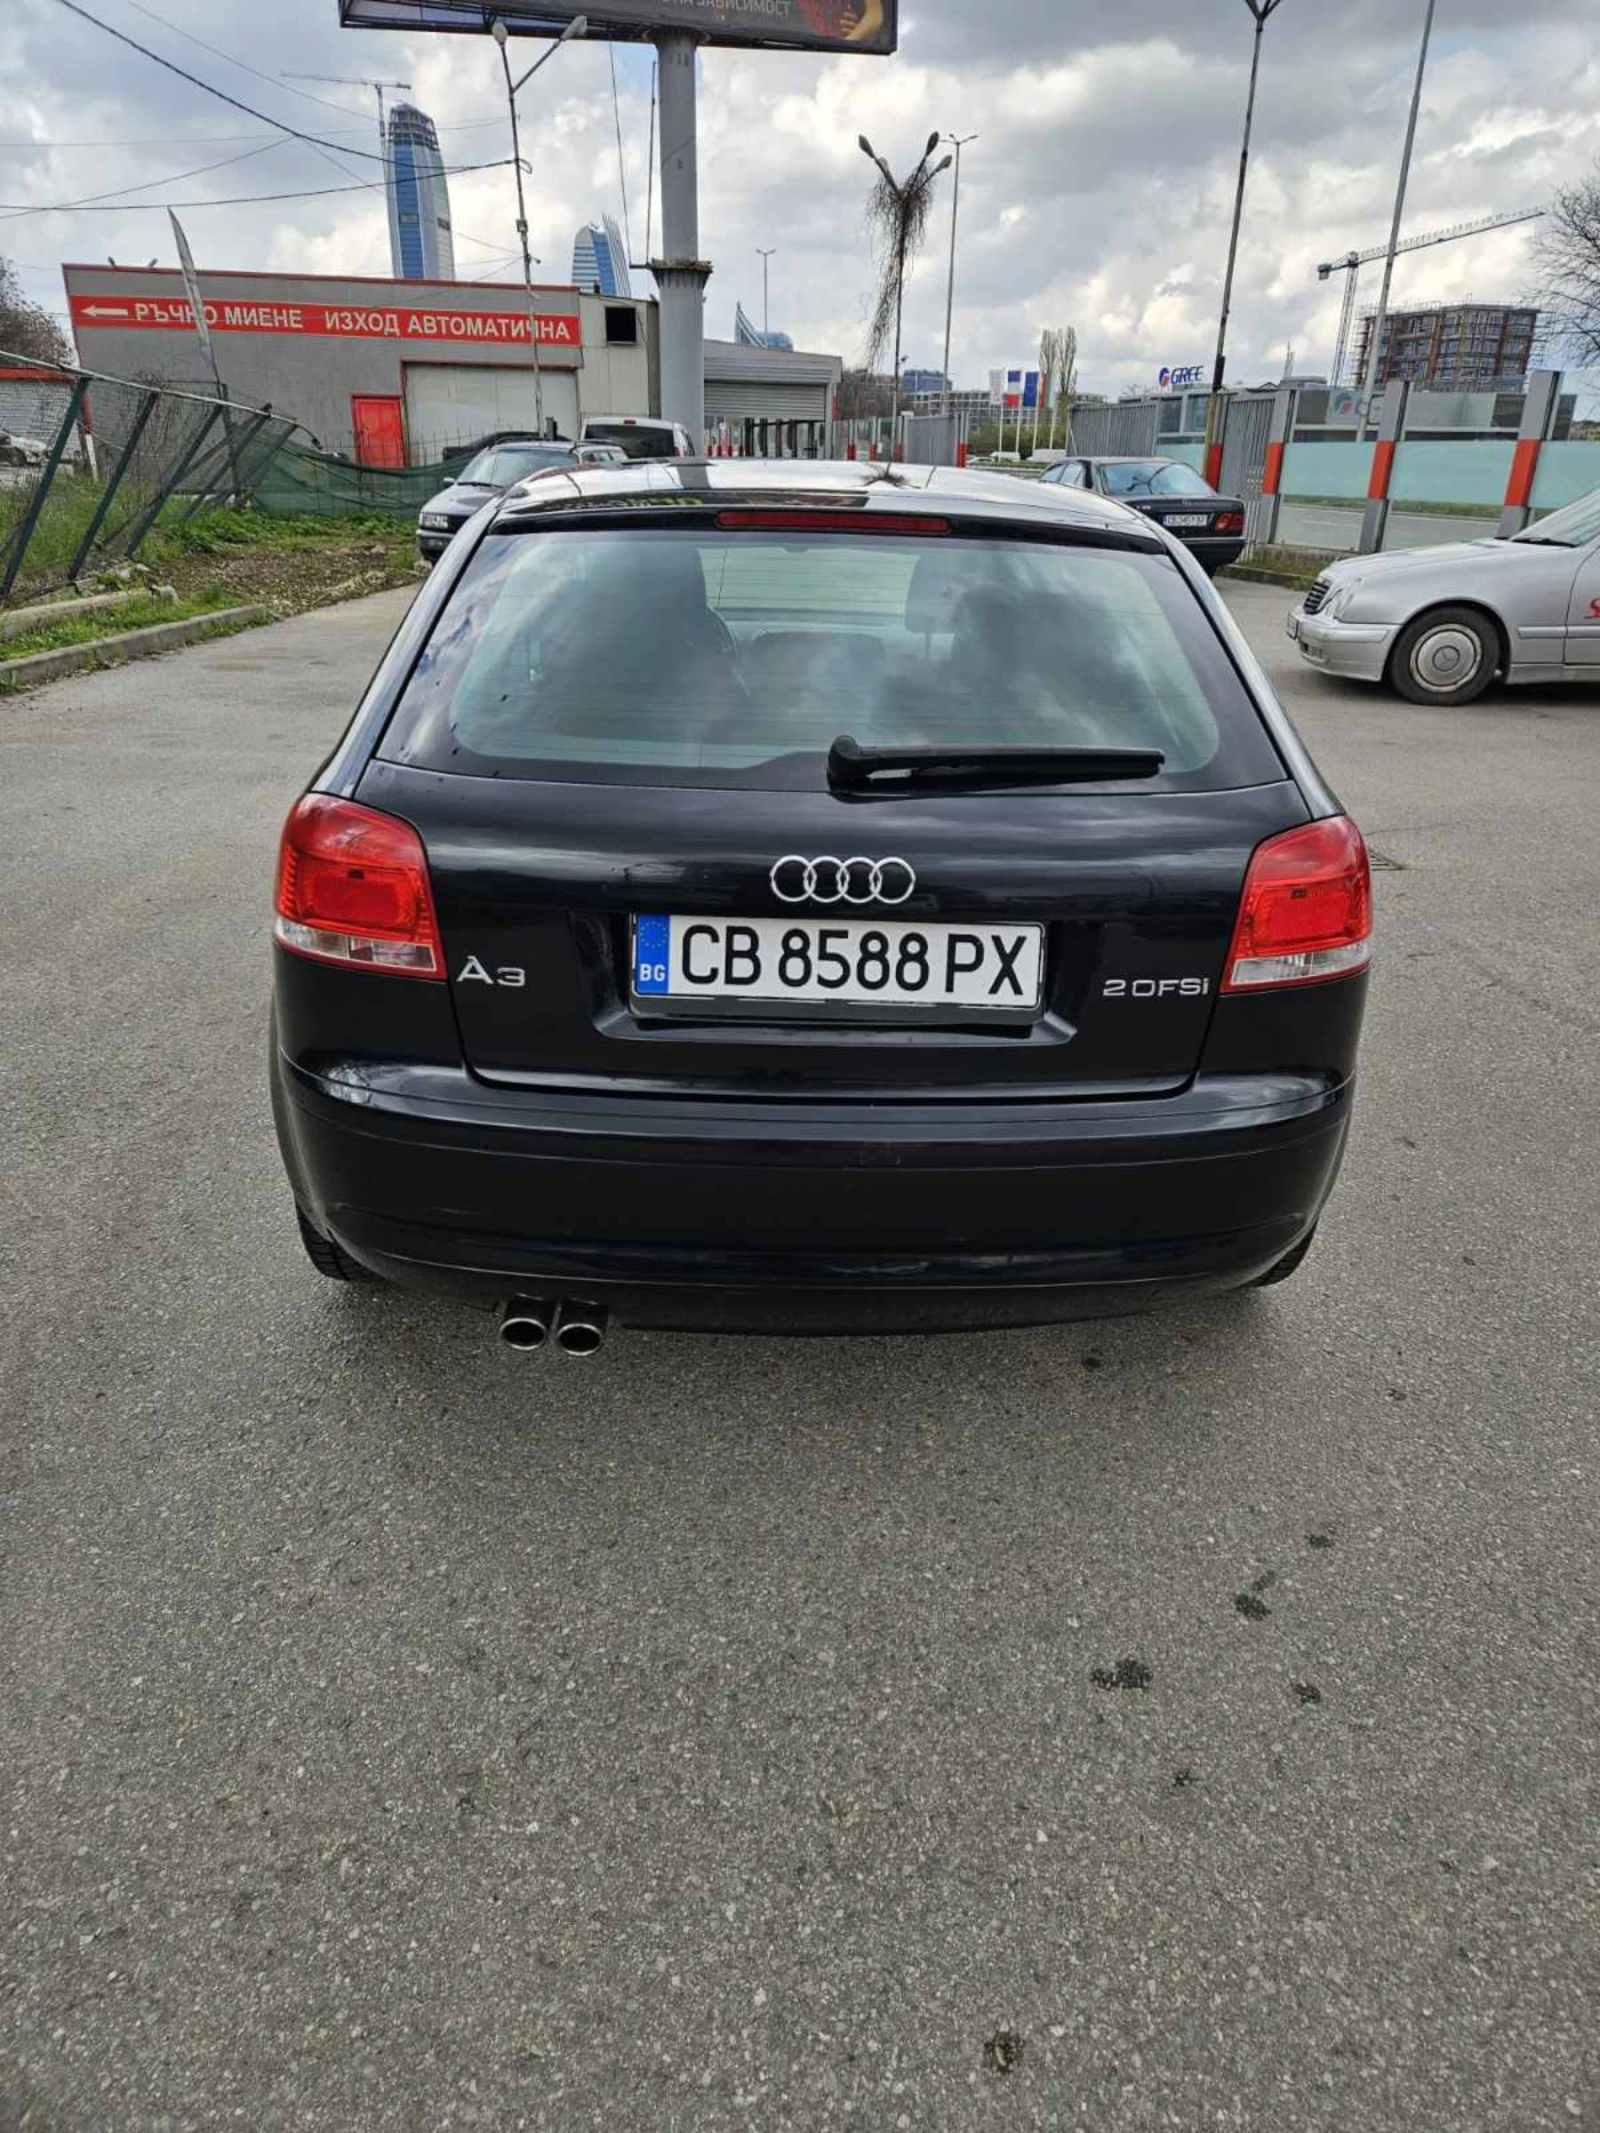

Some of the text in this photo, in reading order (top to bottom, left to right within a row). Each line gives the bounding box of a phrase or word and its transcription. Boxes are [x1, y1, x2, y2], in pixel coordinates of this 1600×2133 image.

[225, 308, 304, 329] МИЕНЕ
[324, 310, 400, 337] ИЗХОД
[407, 314, 571, 340] АВТОМАТИЧНА
[1171, 365, 1204, 385] GREE
[456, 955, 526, 987] A3
[639, 963, 666, 982] BG
[682, 924, 1027, 996] CB 8588 PX
